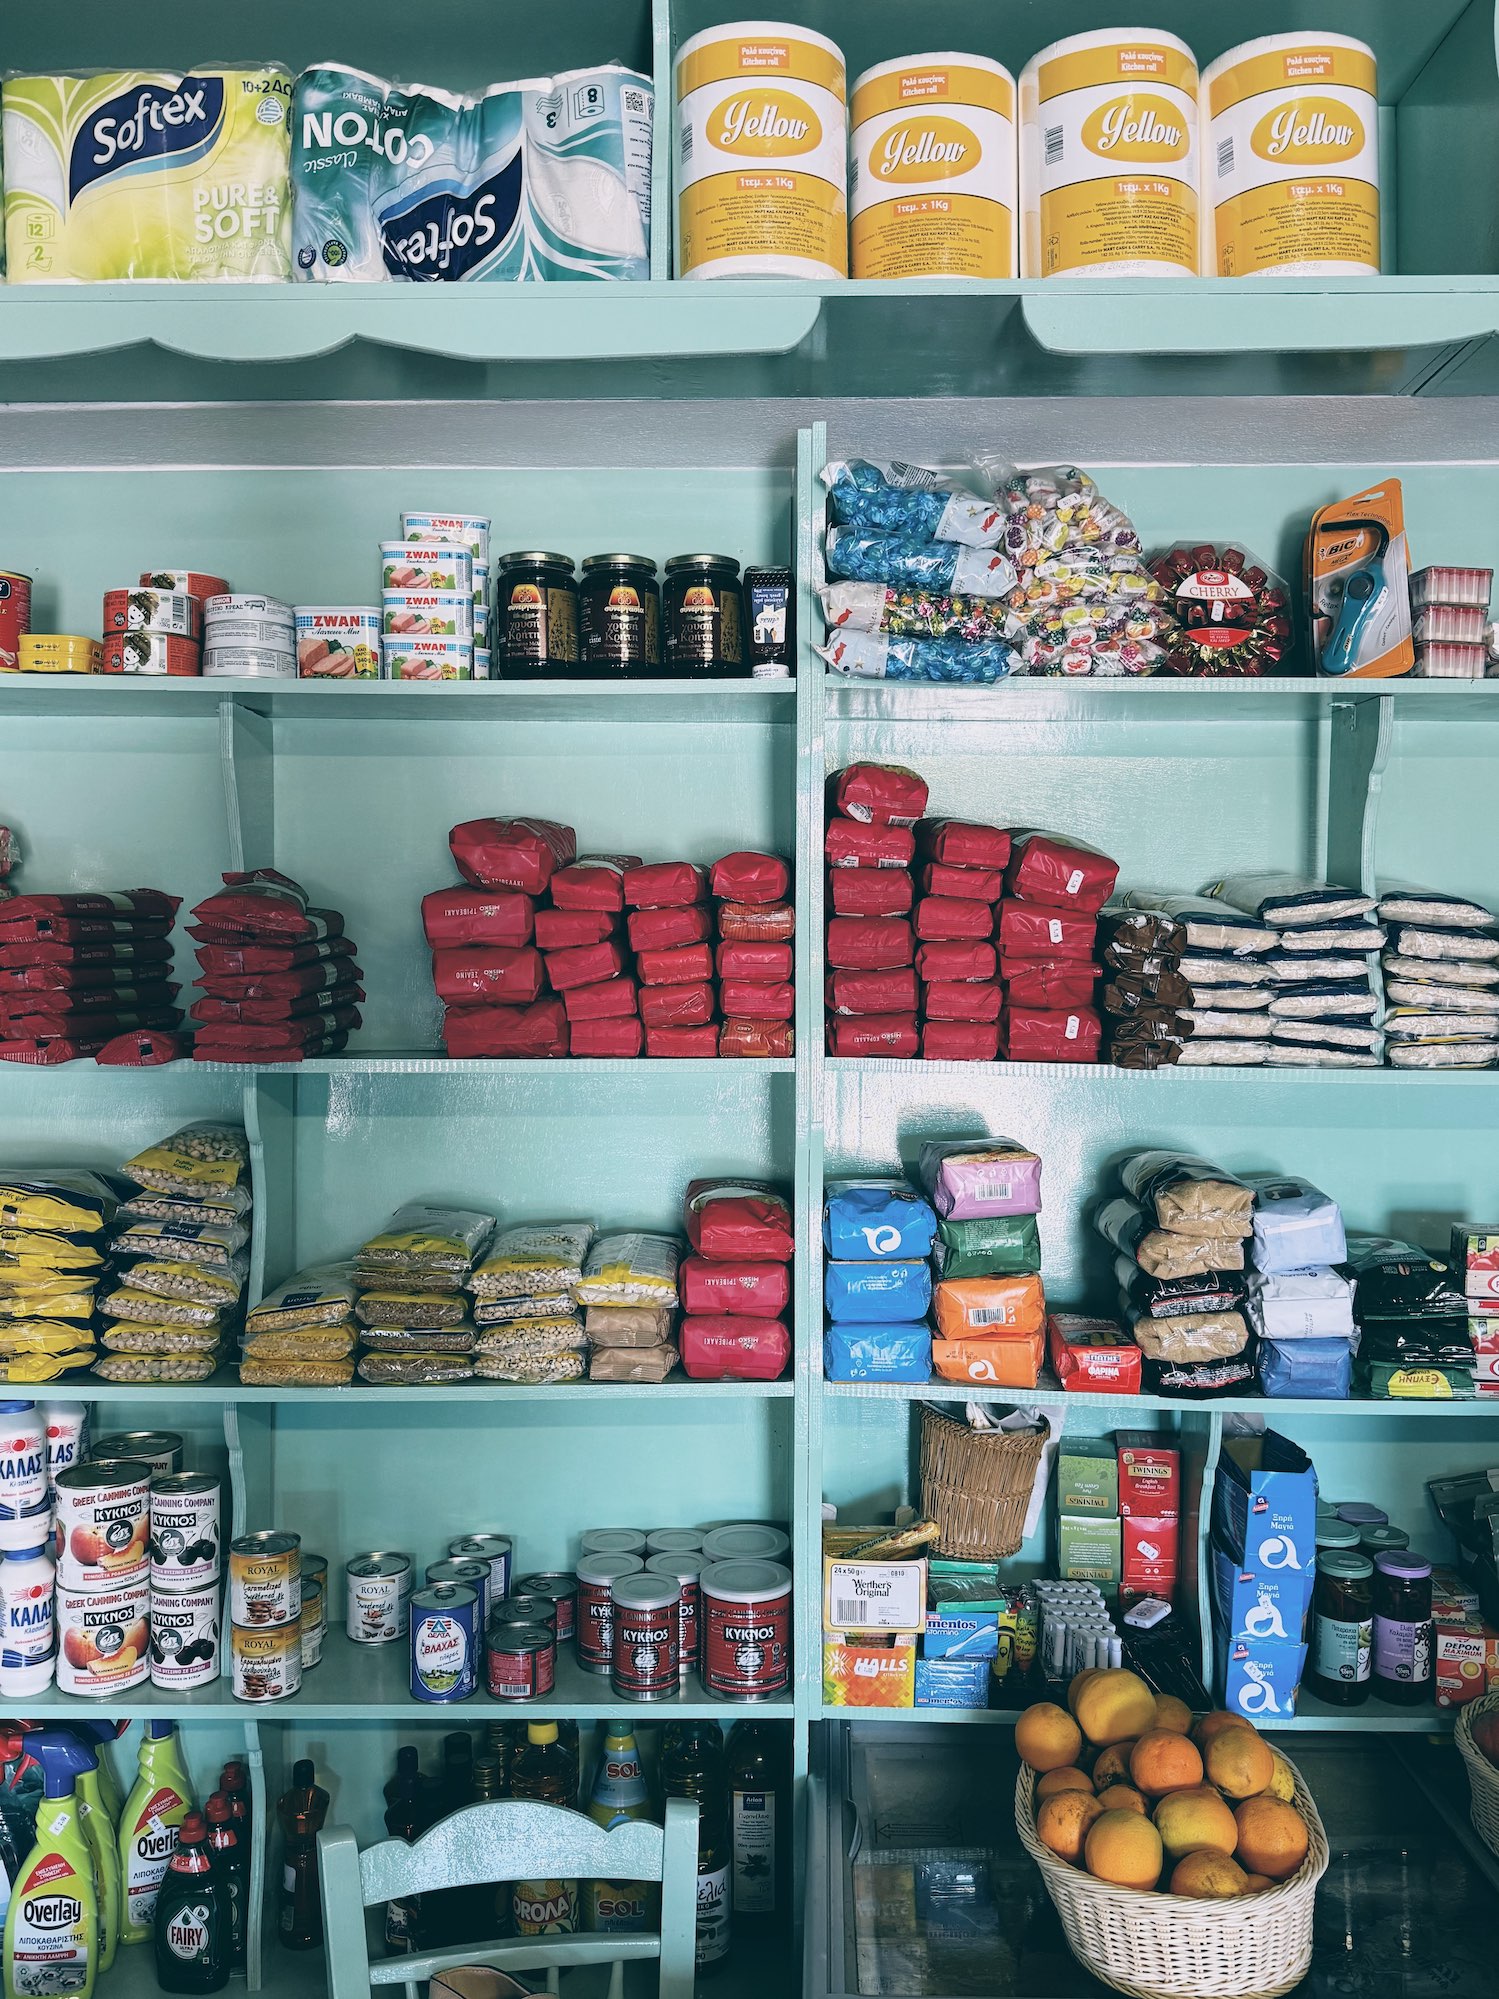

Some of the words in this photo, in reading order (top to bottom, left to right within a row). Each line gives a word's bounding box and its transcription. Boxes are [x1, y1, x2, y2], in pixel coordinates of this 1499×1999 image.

[742, 57, 767, 66] Kitchen
[768, 57, 779, 66] roll
[1121, 63, 1145, 72] Kitchen
[1146, 63, 1157, 72] roll
[1287, 67, 1311, 76] Kitchen
[1313, 66, 1325, 74] roll
[587, 87, 599, 104] 8
[902, 87, 925, 97] Kitchen
[926, 86, 937, 94] roll
[546, 111, 557, 129] 3
[720, 100, 810, 145] Yellow
[93, 89, 207, 165] Softex
[1097, 105, 1183, 151] Yellow
[1267, 111, 1355, 156] Yellow
[880, 128, 968, 176] Yellow
[304, 150, 358, 173] Classic
[775, 178, 794, 190] 1Kg
[1152, 183, 1170, 195] 1Kg
[1325, 184, 1343, 196] 1Kg
[930, 200, 949, 212] 1Kg
[28, 223, 44, 237] 12
[195, 206, 280, 244] SOFT
[34, 245, 45, 262] 2
[431, 519, 463, 528] ZWAN
[405, 551, 438, 559] ZWAN
[1189, 586, 1239, 597] CHERRY
[405, 597, 438, 605] ZWAN
[1320, 599, 1340, 609] Relax
[313, 615, 360, 627] ZWAN
[607, 621, 639, 633] χρυσή
[681, 621, 713, 633] χρυσή
[605, 632, 639, 643] Κρήτη
[680, 632, 713, 643] Κρήτη
[413, 642, 447, 651] ZWAN
[1088, 1366, 1120, 1377] ΦΑΡΙΝΑ
[1132, 1467, 1169, 1475] TWININGS
[72, 1495, 96, 1508] GREEK
[97, 1488, 131, 1503] CANNING
[154, 1497, 184, 1508] CANNING
[184, 1497, 215, 1508] COMPANY
[1069, 1497, 1106, 1505] TWININGS
[95, 1502, 141, 1521] KYKNOS
[153, 1513, 196, 1526] KYKNOS
[1272, 1513, 1293, 1523] Ξηρή
[1270, 1521, 1294, 1531] Μαγιά
[247, 1565, 280, 1575] ROYAL
[834, 1567, 842, 1575] 24
[847, 1568, 855, 1576] 50
[1071, 1569, 1108, 1578] TWININGS
[243, 1580, 282, 1592] Caramelized
[361, 1585, 390, 1595] ROYAL
[852, 1578, 893, 1590] Werther's
[1258, 1582, 1279, 1592] Ξηρή
[855, 1587, 890, 1599] Original
[65, 1597, 86, 1610] GREEK
[88, 1594, 122, 1607] CANNING
[180, 1597, 214, 1608] COMPANY
[357, 1600, 386, 1610] Sweetened
[84, 1606, 134, 1625] KYKNOS
[153, 1612, 194, 1626] KYKNOS
[927, 1618, 976, 1630] mentos
[623, 1627, 669, 1641] KYKNOS
[724, 1625, 774, 1641] KYKNOS
[244, 1640, 276, 1649] ROYAL
[424, 1637, 460, 1655] ΒΛΑΧΑΣ
[1445, 1642, 1479, 1652] DEPON
[1443, 1648, 1483, 1658] MAXIMUM
[606, 1762, 641, 1780] SOL
[137, 1832, 180, 1858] Overla
[23, 1900, 82, 1925] Overlay
[597, 1899, 644, 1918] SOL
[18, 1932, 85, 1946] ΛΙΠΟΚΑΘΑΡΙΣΤΗΣ
[171, 1926, 204, 1946] FAIRY
[37, 1942, 63, 1951] ΚΟΥΖΙΝΑ
[23, 1952, 48, 1961] ΑΝΙΚΗΤΗ
[48, 1951, 69, 1960] ΛΑΜΨΗ
